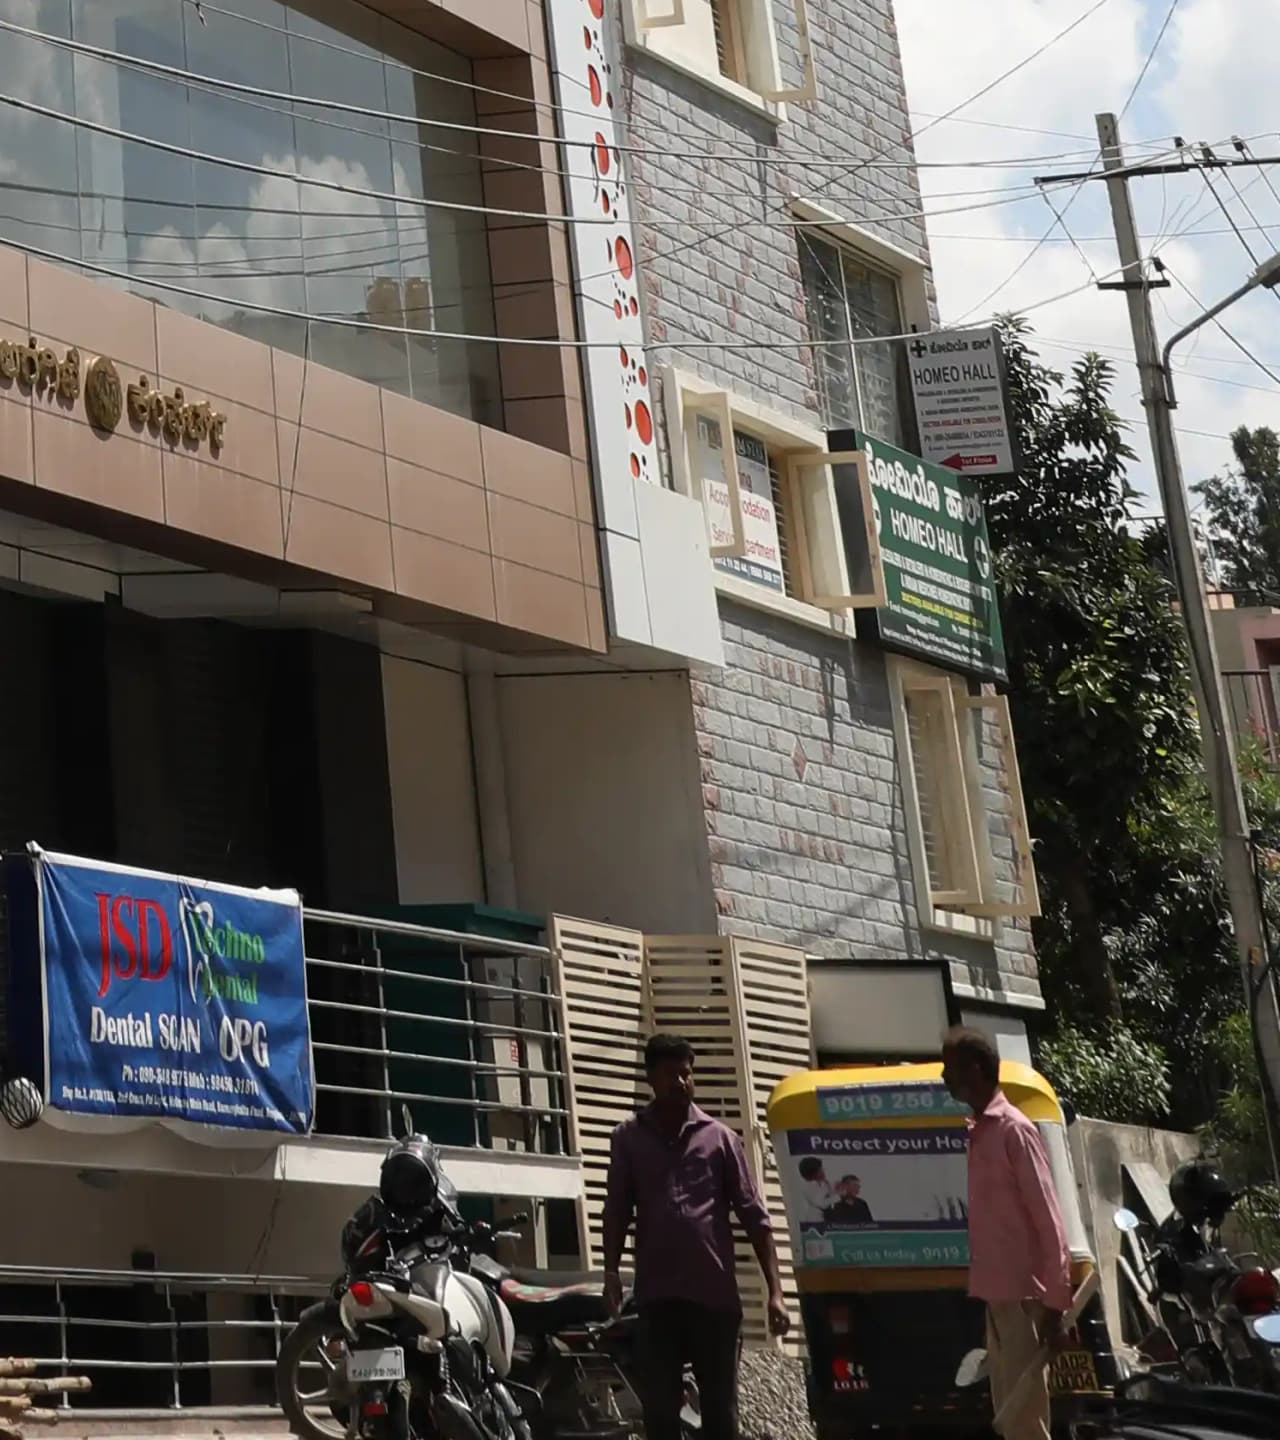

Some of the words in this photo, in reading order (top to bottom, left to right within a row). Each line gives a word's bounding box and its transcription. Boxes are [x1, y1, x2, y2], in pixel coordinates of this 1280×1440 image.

[913, 365, 960, 385] HOMEO
[962, 363, 996, 380] HALL
[890, 507, 936, 551] HOMEO
[938, 528, 968, 564] HALL
[95, 891, 173, 998] JSD
[90, 1005, 153, 1049] Dental
[158, 1013, 201, 1055] SCAN
[219, 1015, 270, 1068] OPG
[824, 1093, 883, 1113] 9019
[809, 1134, 881, 1151] Protect
[886, 1136, 931, 1154] your
[935, 1135, 970, 1150] Hea
